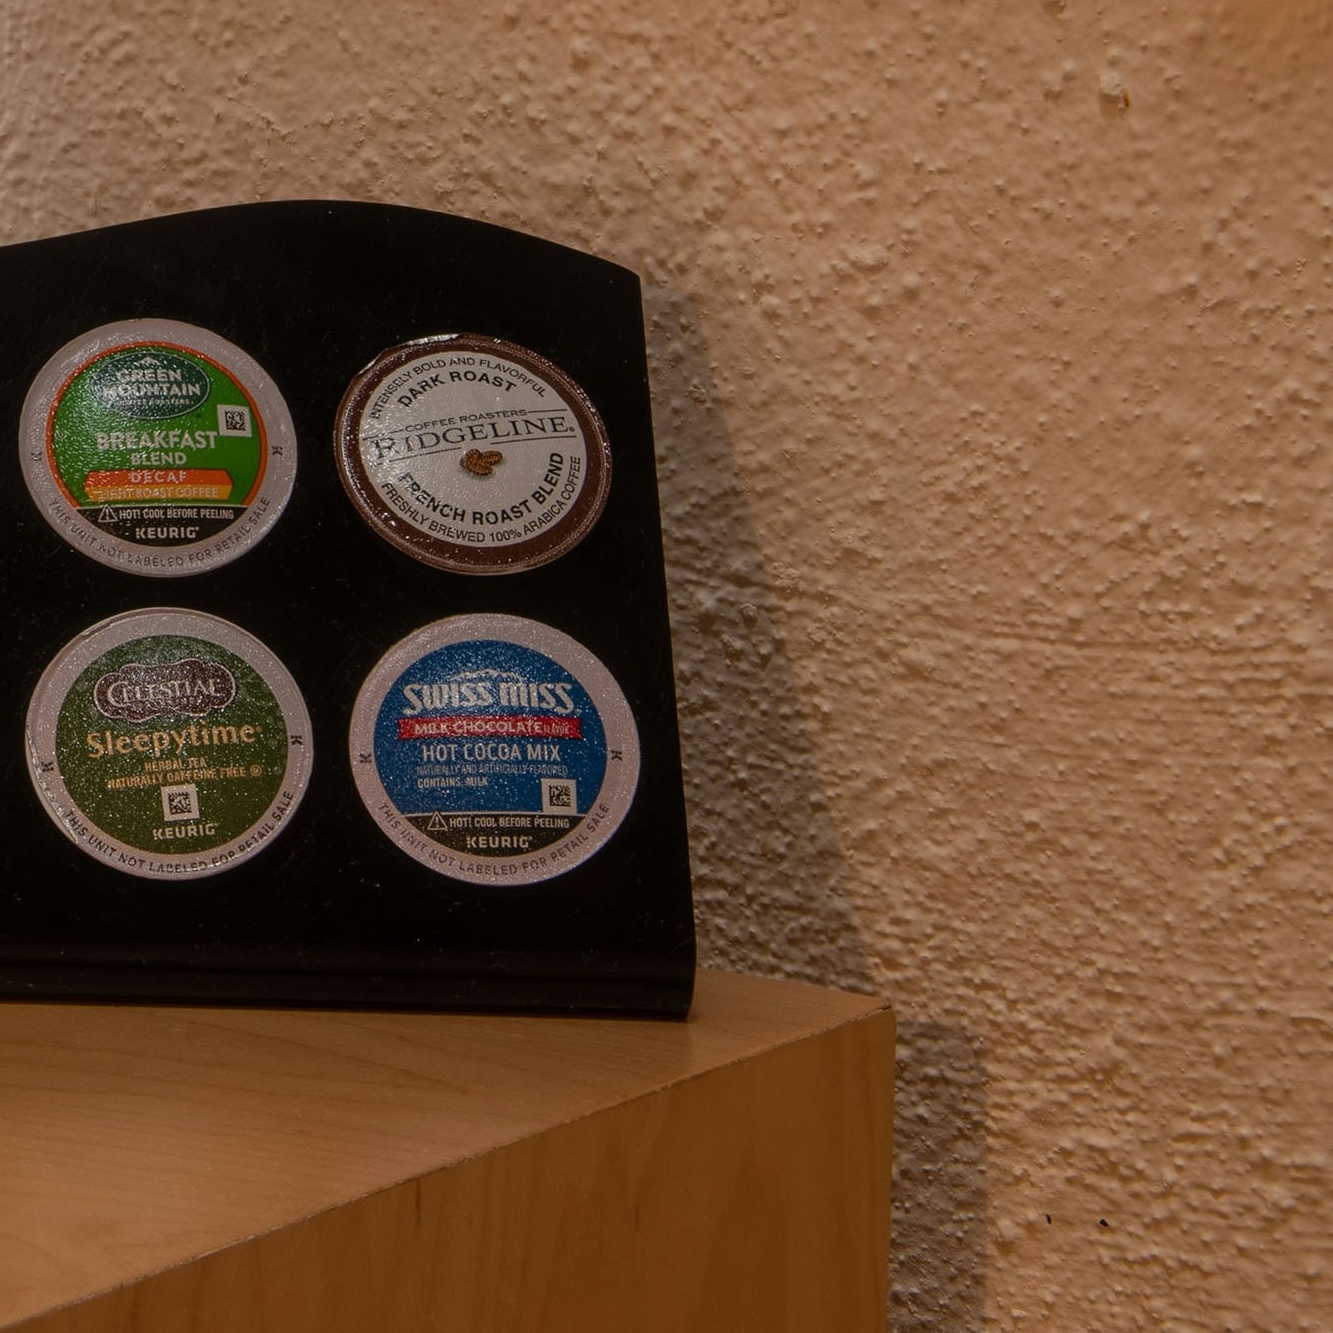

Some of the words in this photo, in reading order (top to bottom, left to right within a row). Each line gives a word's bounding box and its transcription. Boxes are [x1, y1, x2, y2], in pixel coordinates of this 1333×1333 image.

[116, 370, 182, 384] GREEN
[102, 382, 201, 397] MOUNTAIN
[371, 371, 413, 419] INTENSELY
[413, 359, 447, 376] BOLD
[449, 357, 476, 367] AND
[479, 359, 548, 398] FLAVORFUL
[397, 374, 445, 408] DARK
[450, 370, 517, 393] ROAST
[405, 417, 457, 433] COFFEE
[459, 409, 528, 422] ROASTERS
[96, 430, 217, 452] BREAKFAST
[131, 451, 187, 466] BLEND
[131, 471, 188, 483] DECAF
[136, 487, 174, 500] ROAST
[175, 487, 219, 499] COFFEE
[397, 472, 466, 524] FRENCH
[472, 502, 533, 525] ROAST
[530, 452, 564, 506] BLEND
[381, 481, 428, 525] FRESHLY
[427, 521, 486, 543] BREWED
[489, 528, 522, 543] 100%
[523, 500, 566, 536] ARABICA
[562, 455, 581, 502] COFFEE
[119, 508, 141, 520] HOT!
[143, 508, 165, 520] COOL
[166, 508, 198, 520] BEFORE
[200, 509, 234, 520] PEELING
[128, 554, 185, 567] LABELED
[188, 548, 213, 564] FOR
[215, 524, 252, 555] RETAIL
[250, 497, 271, 529] SALE
[136, 526, 195, 539] KEURIG
[415, 723, 449, 735] MILK
[453, 720, 542, 734] CHOCOLATE
[86, 721, 258, 758] Sleepytime
[422, 744, 456, 762] HOT
[464, 744, 520, 762] COCOA
[527, 744, 562, 762] MIX
[145, 758, 182, 772] HERBAL
[185, 757, 207, 769] TEA
[107, 773, 164, 790] NATURALLY
[167, 769, 217, 784] CAFFEINE
[219, 767, 246, 778] FREE
[465, 777, 489, 787] MILK
[449, 817, 472, 828] HOT!
[474, 817, 497, 828] COOL
[498, 816, 532, 828] BEFORE
[534, 817, 570, 829] PEELING
[65, 810, 88, 836] THIS
[88, 834, 117, 857] UNIT
[118, 853, 145, 871] NOT
[149, 860, 208, 873] LABELED
[212, 850, 238, 866] FOR
[239, 823, 275, 853] RETAIL
[273, 790, 294, 821] SALE
[153, 824, 216, 840] KEURIG
[378, 802, 399, 829] THIS
[400, 829, 426, 852] UNIT
[429, 848, 457, 866] NOT
[459, 859, 518, 875] LABELED
[522, 857, 547, 872] FOR
[551, 833, 589, 863] RETAIL
[586, 804, 610, 834] SALE
[466, 835, 529, 849] KEURIG
